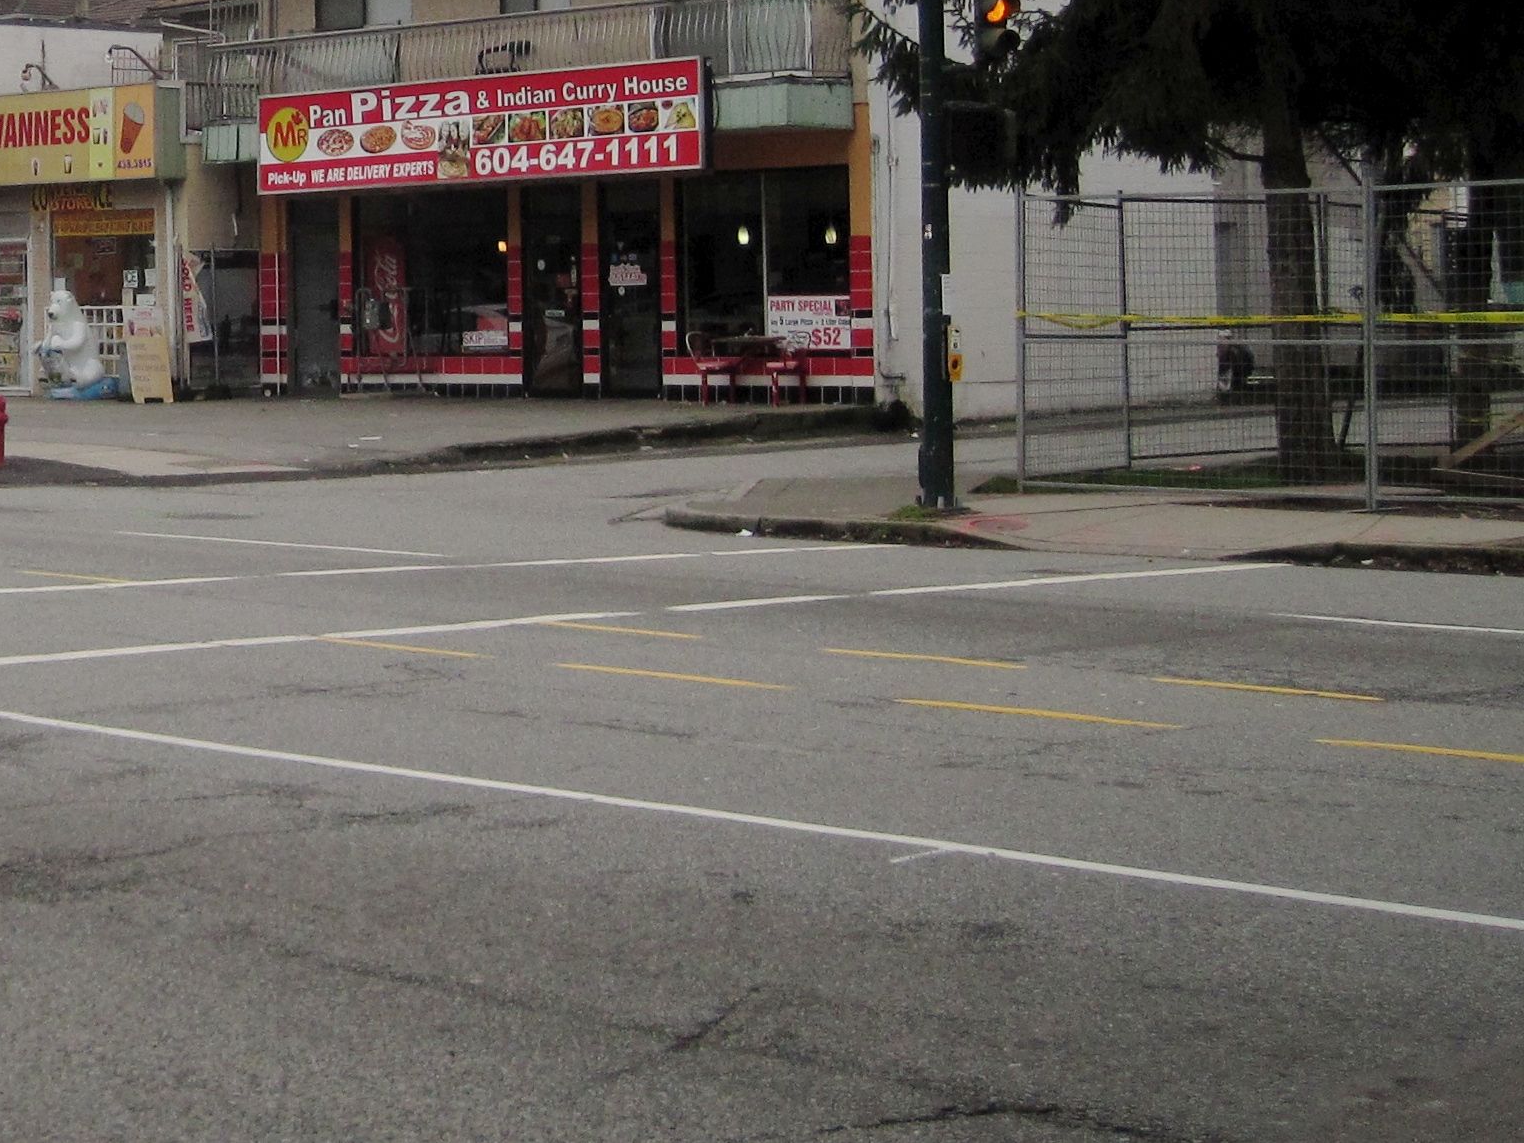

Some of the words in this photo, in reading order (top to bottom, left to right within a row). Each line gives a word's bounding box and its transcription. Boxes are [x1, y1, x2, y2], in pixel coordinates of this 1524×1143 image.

[308, 105, 346, 128] Pan
[350, 89, 470, 125] Pizza
[476, 90, 490, 109] &
[497, 86, 556, 107] Indian
[562, 81, 617, 102] Curry
[623, 75, 688, 96] House
[475, 134, 678, 175] 604-647-1111
[311, 168, 325, 183] WE
[326, 167, 345, 182] ARE
[346, 163, 390, 180] DELIVERY
[392, 161, 434, 178] EXPERTS
[183, 298, 195, 332] HERE
[770, 300, 795, 311] PARTY
[798, 300, 832, 312] SPECIAL
[811, 327, 841, 346] $52
